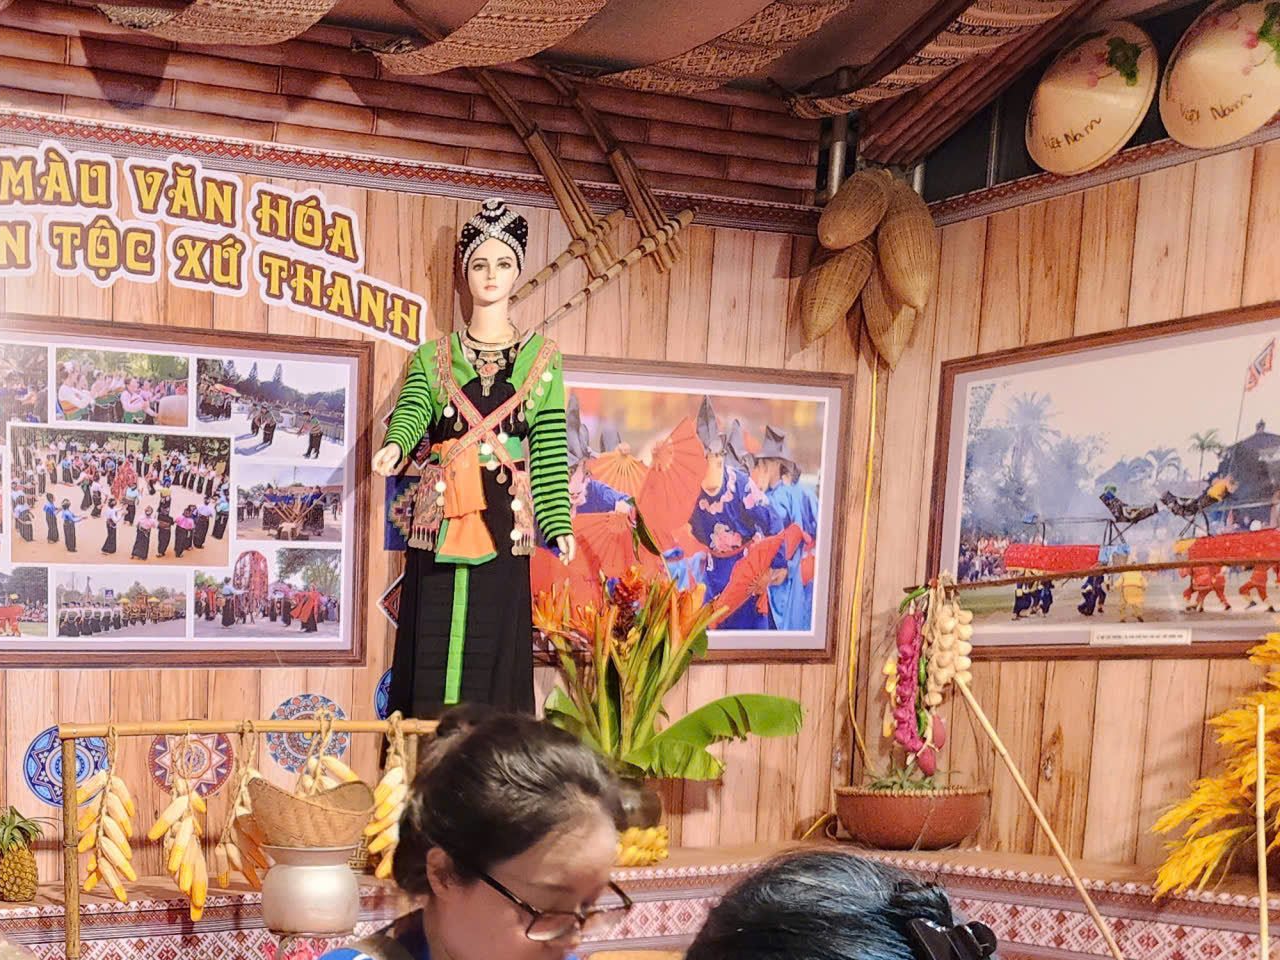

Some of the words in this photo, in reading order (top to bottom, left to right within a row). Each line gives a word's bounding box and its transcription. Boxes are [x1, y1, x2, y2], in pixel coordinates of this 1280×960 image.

[1064, 117, 1102, 145] Nam
[1211, 94, 1253, 120] Nam
[130, 162, 237, 228] VĂN
[252, 189, 358, 263] HÓA
[49, 215, 155, 280] TỘC
[174, 233, 245, 290] XỨ
[260, 251, 421, 345] THANH
